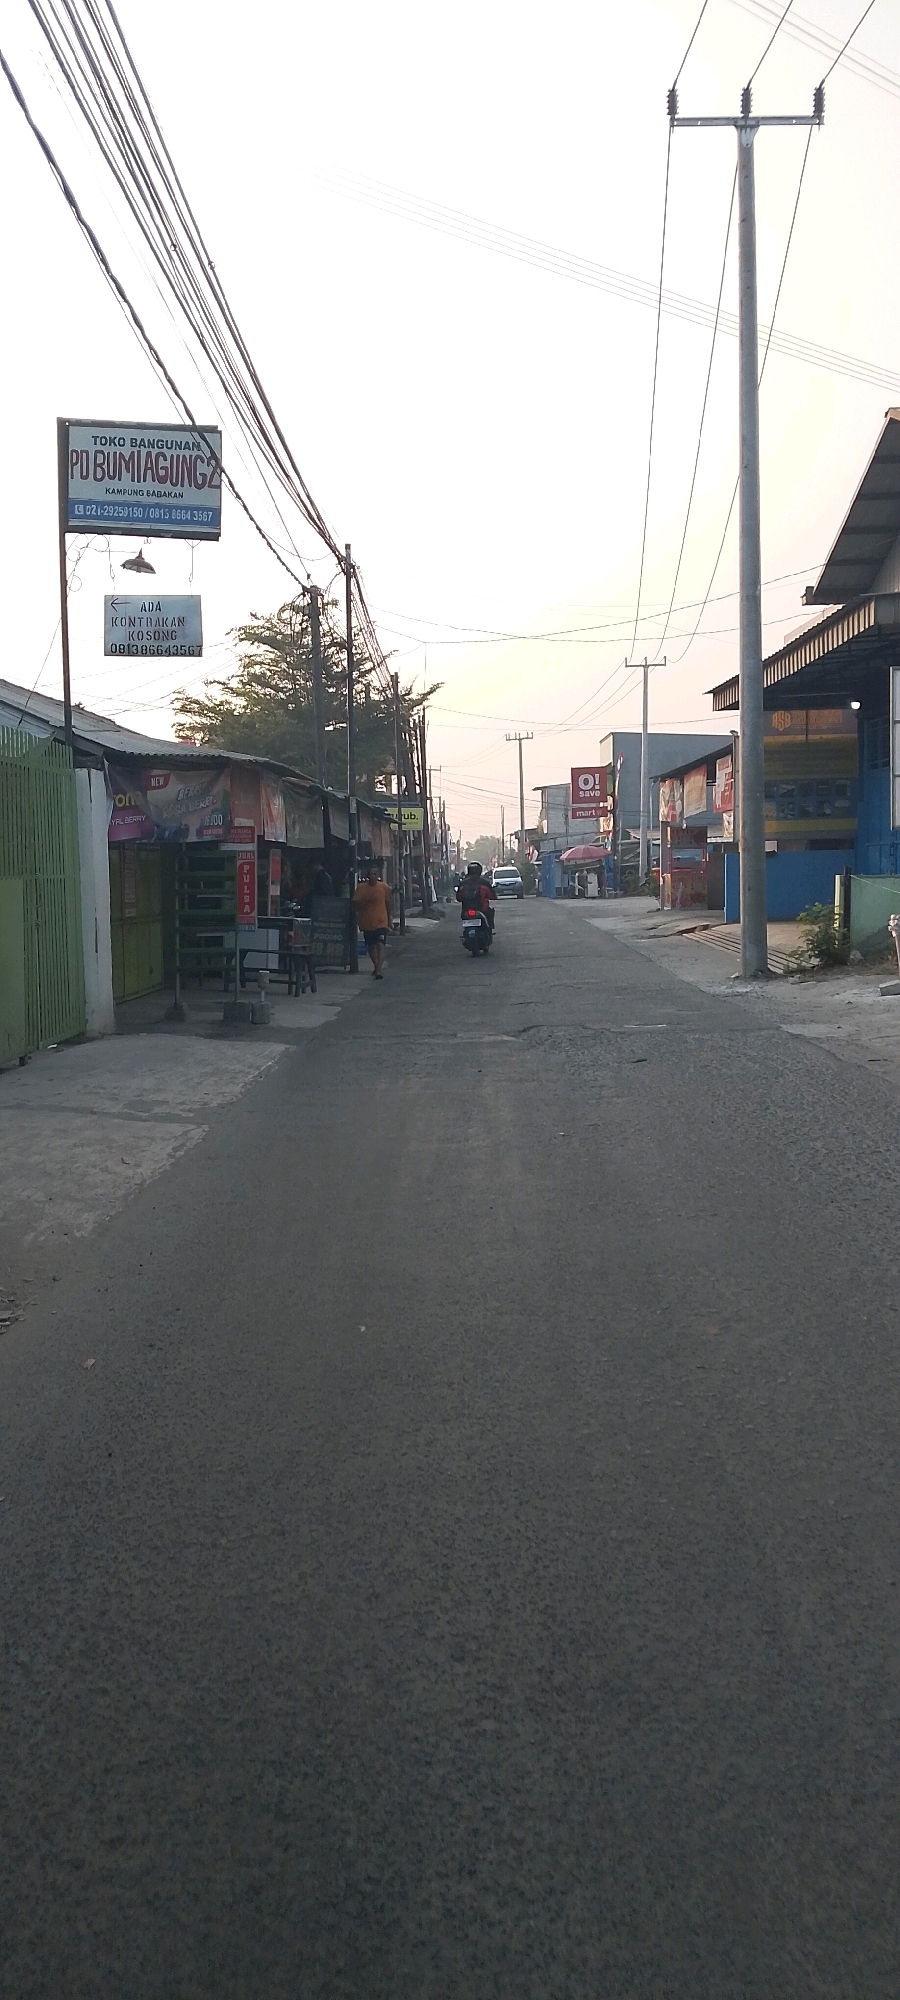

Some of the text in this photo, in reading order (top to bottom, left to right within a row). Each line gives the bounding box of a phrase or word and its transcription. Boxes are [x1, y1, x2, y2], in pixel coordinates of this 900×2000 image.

[91, 435, 201, 451] TOKO BANGUNAN
[70, 449, 90, 480] PD
[105, 487, 184, 499] KAMPUNG BABAKAN
[85, 504, 143, 518] 021-29259150
[149, 508, 170, 519] 0813
[171, 509, 191, 520] 8664
[193, 510, 213, 522] 3567
[140, 601, 162, 613] ADA
[111, 616, 185, 628] KONTRAKAN
[128, 630, 178, 642] KOSONG
[110, 643, 203, 657] 081386643567
[151, 777, 165, 787] NEW
[578, 773, 600, 791] O!
[579, 790, 601, 798] save
[576, 808, 596, 817] mart
[110, 814, 147, 826] YAL BERRY
[238, 852, 255, 860] JUAL
